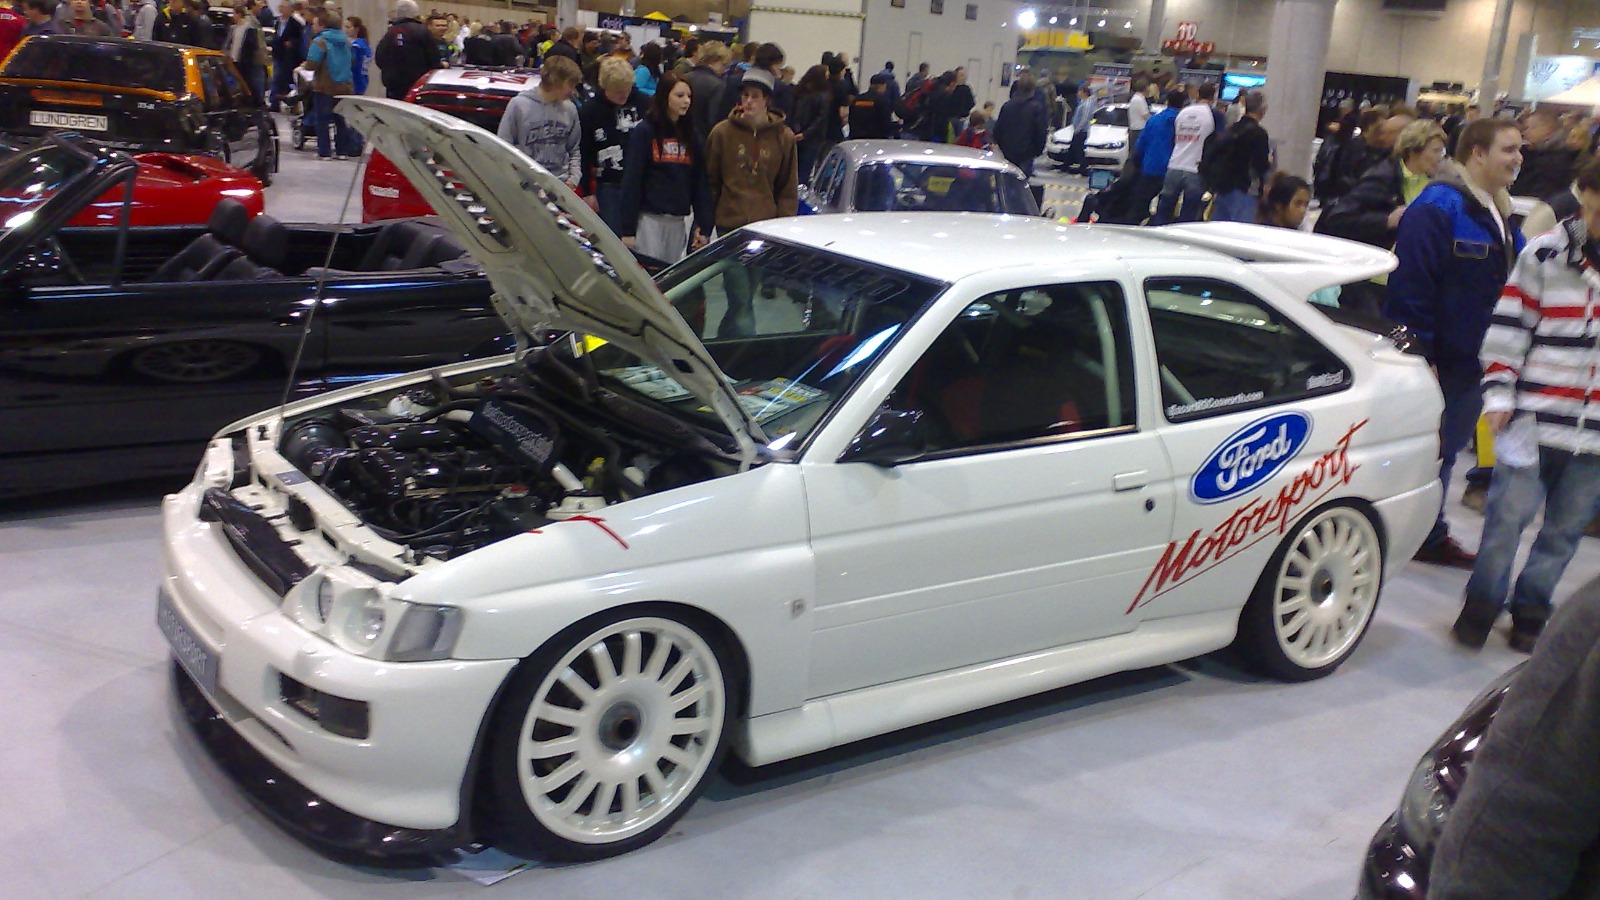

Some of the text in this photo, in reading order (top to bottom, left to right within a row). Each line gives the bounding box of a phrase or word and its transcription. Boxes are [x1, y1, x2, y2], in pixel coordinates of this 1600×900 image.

[33, 113, 106, 128] LUNDGREN
[1215, 422, 1292, 492] Ford
[1124, 418, 1369, 615] Motorsport
